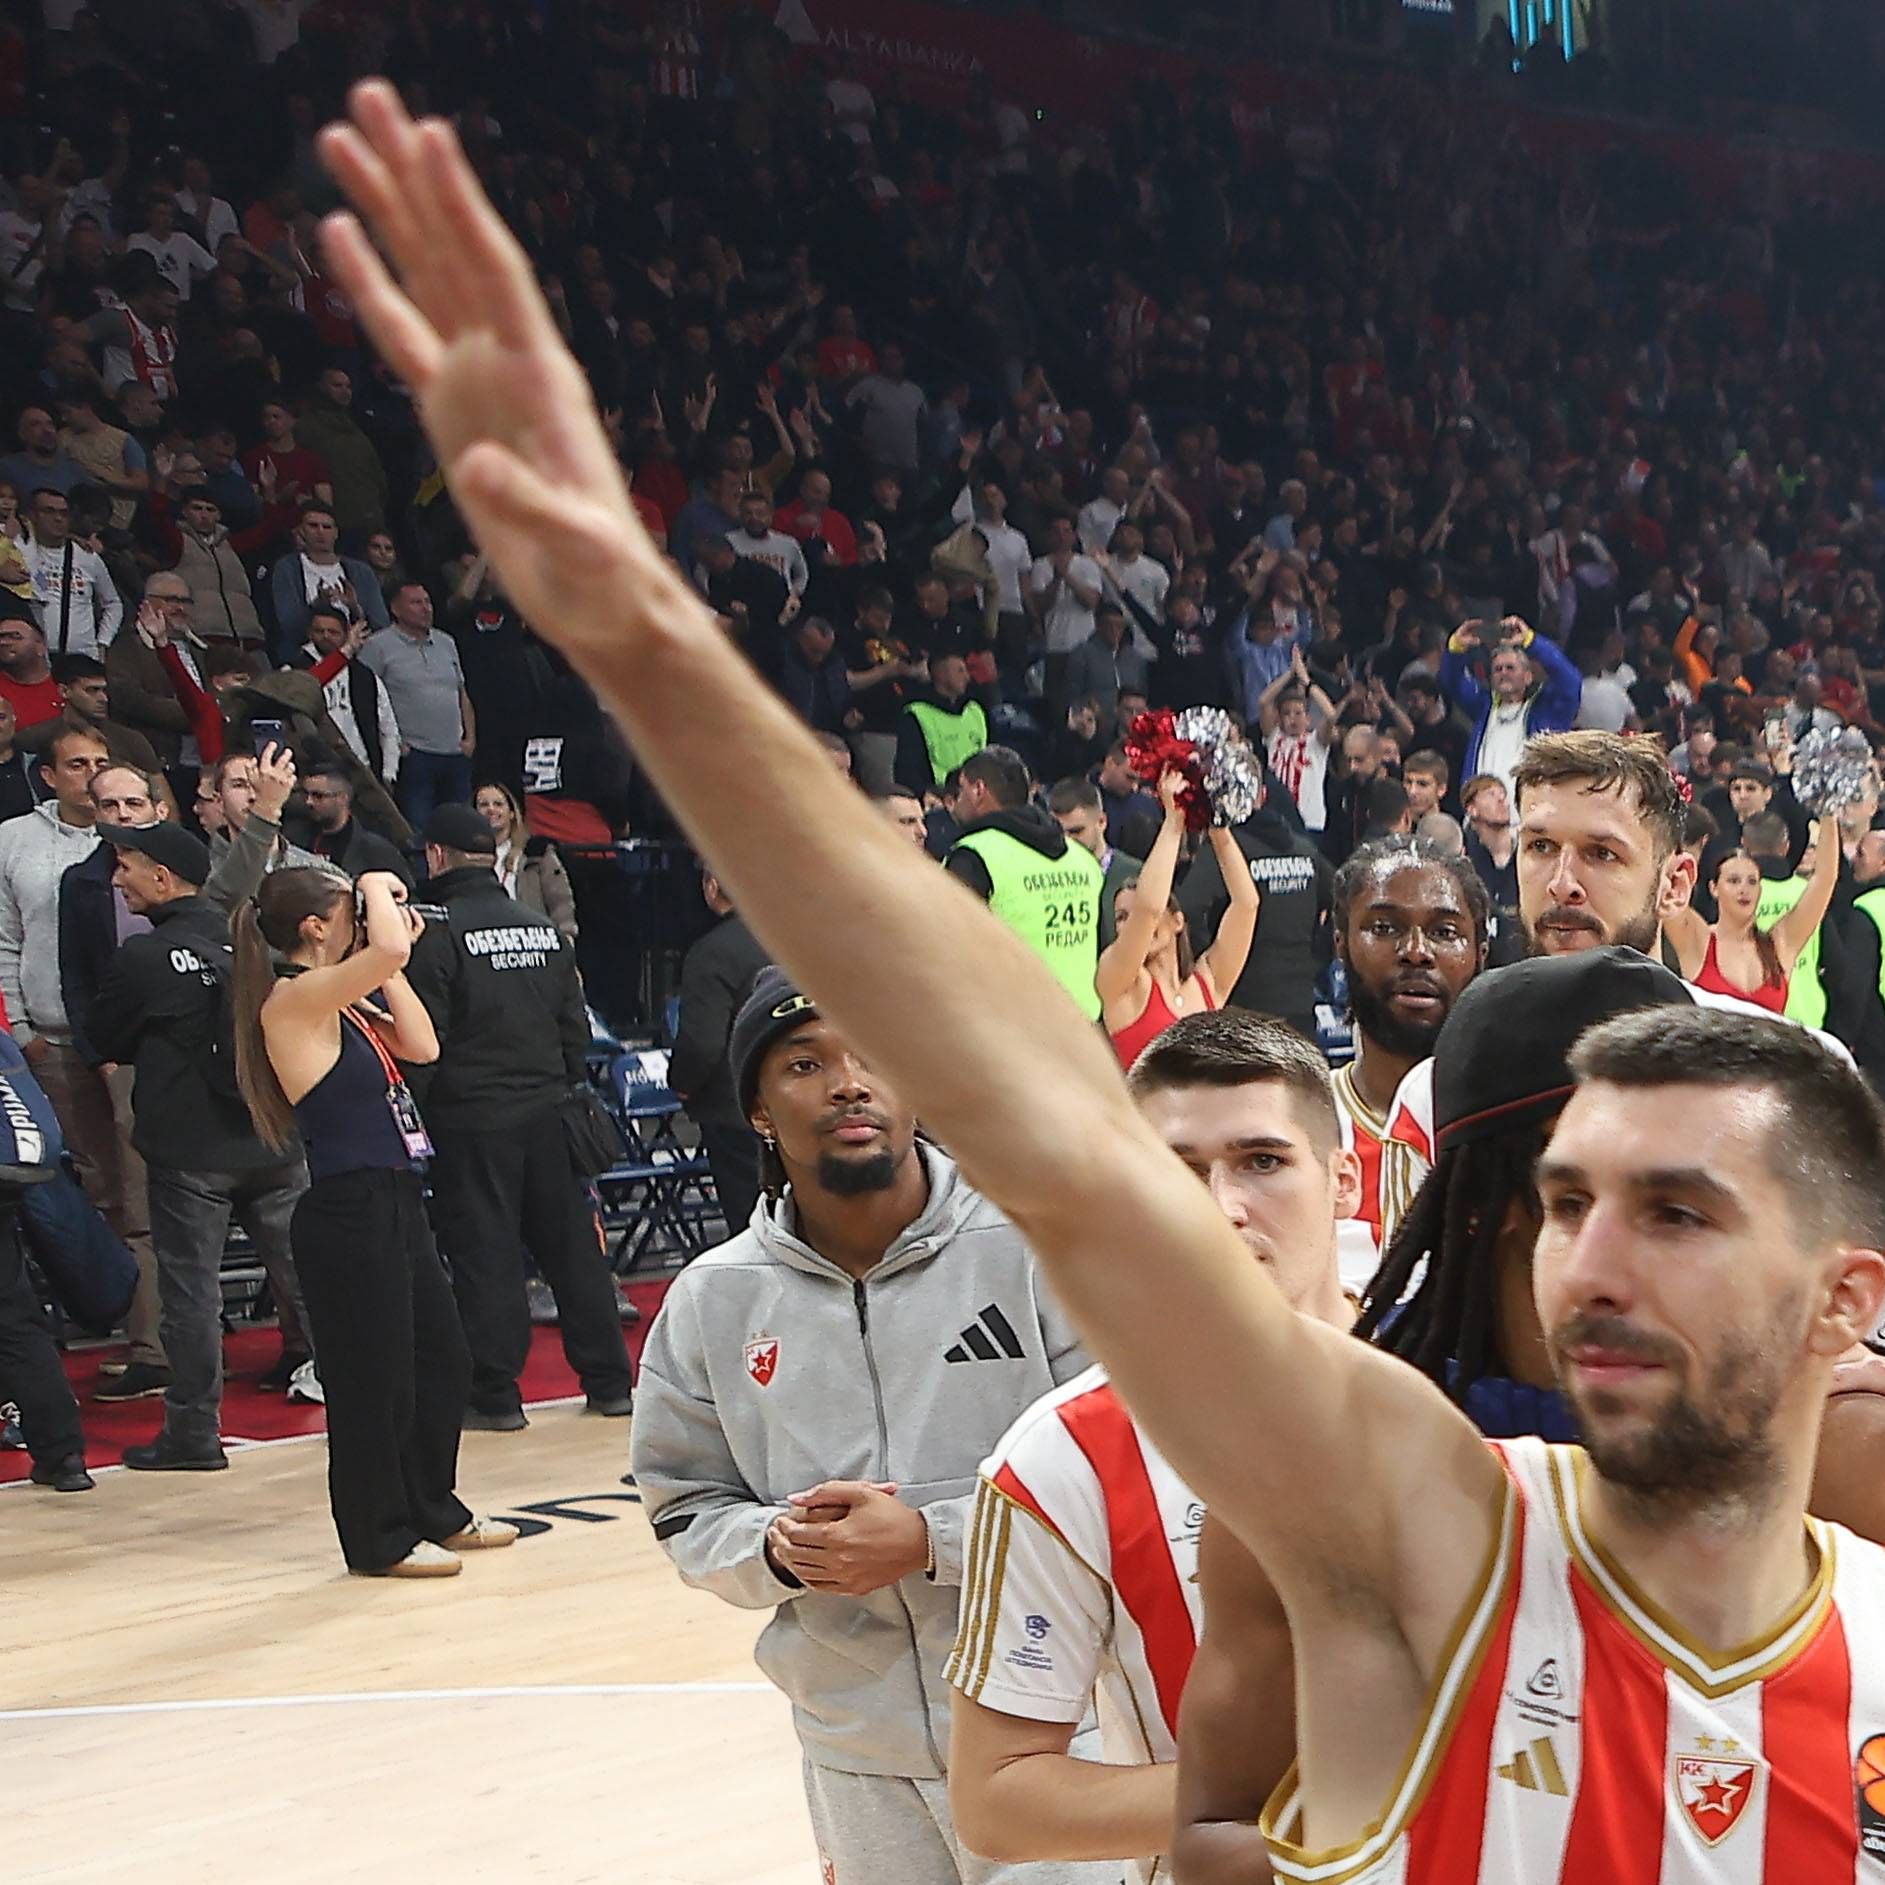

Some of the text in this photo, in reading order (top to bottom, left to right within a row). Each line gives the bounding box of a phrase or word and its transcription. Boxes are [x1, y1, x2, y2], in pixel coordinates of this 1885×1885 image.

[1044, 900, 1091, 928] 245
[1045, 930, 1089, 949] РЕДАР
[490, 951, 547, 970] SECURITY
